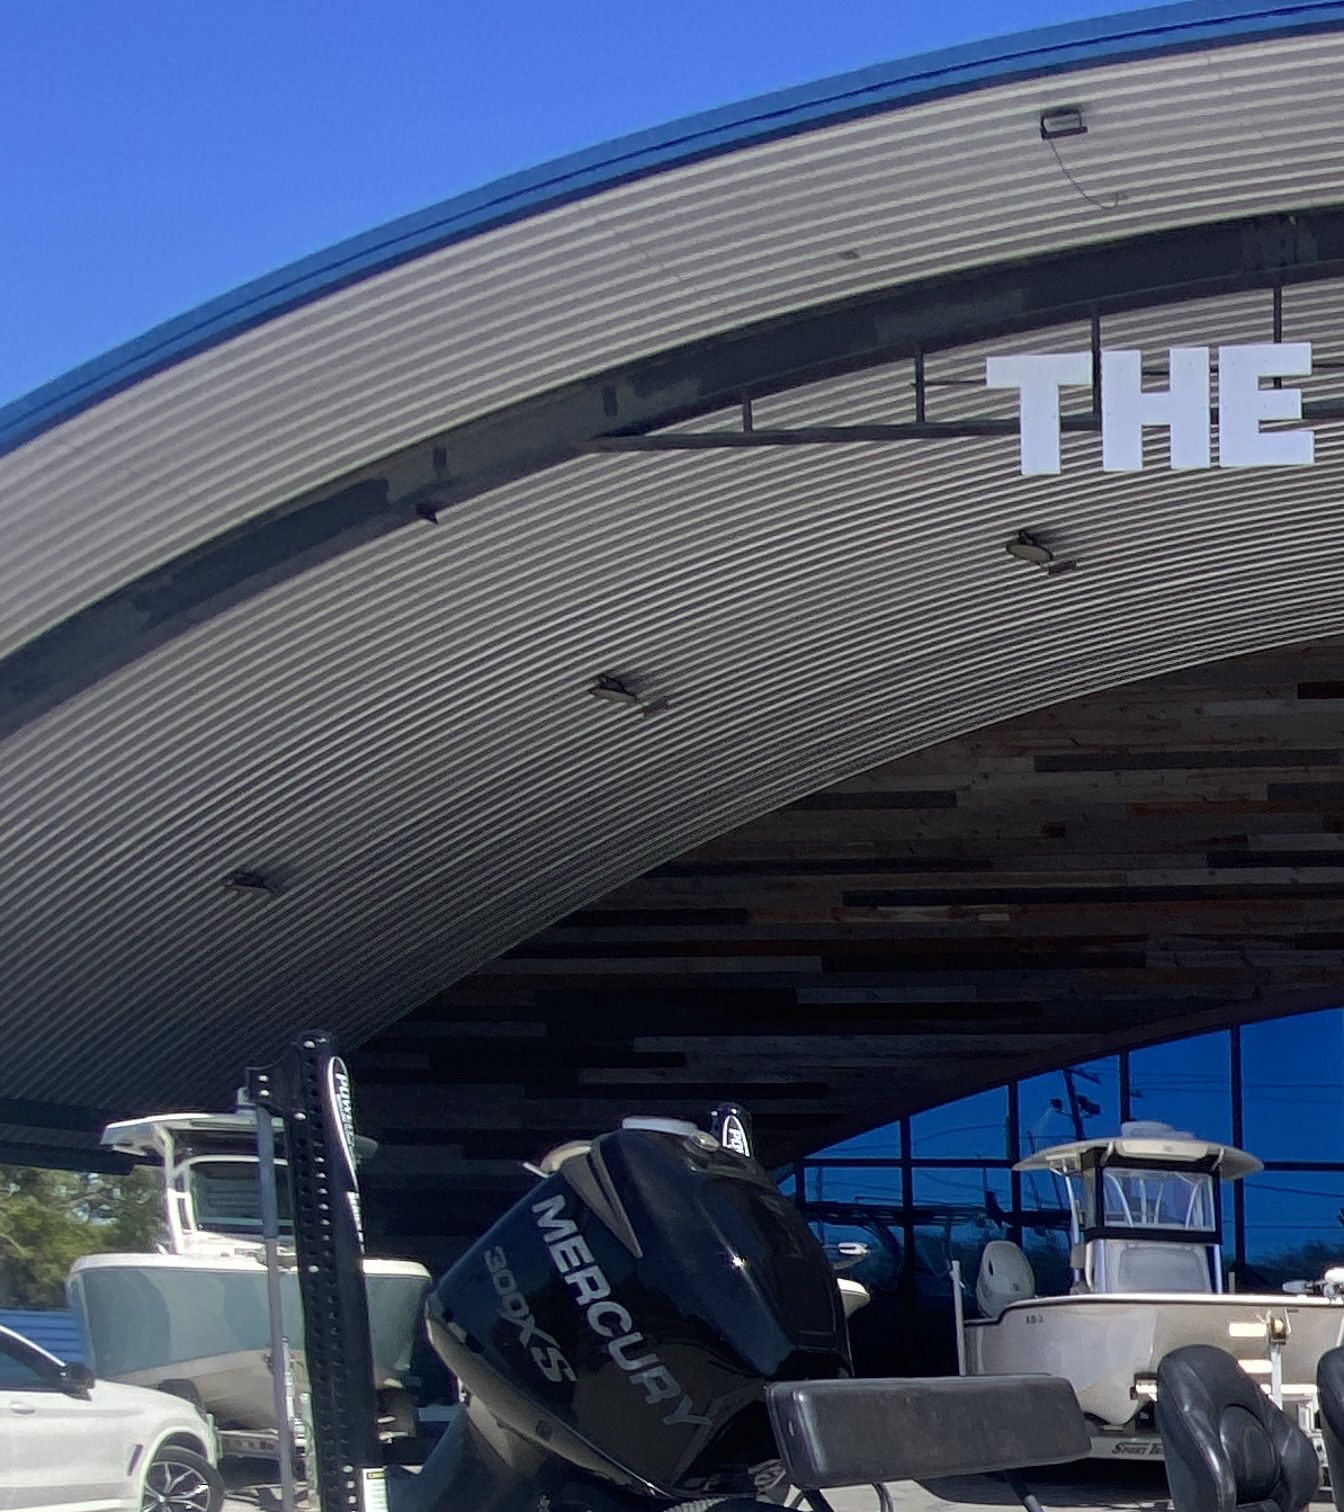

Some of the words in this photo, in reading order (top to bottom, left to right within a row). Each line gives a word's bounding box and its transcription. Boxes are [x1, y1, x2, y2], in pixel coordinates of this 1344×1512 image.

[985, 342, 1316, 477] THE
[483, 1244, 578, 1384] 300XS
[531, 1193, 713, 1427] MERCURY
